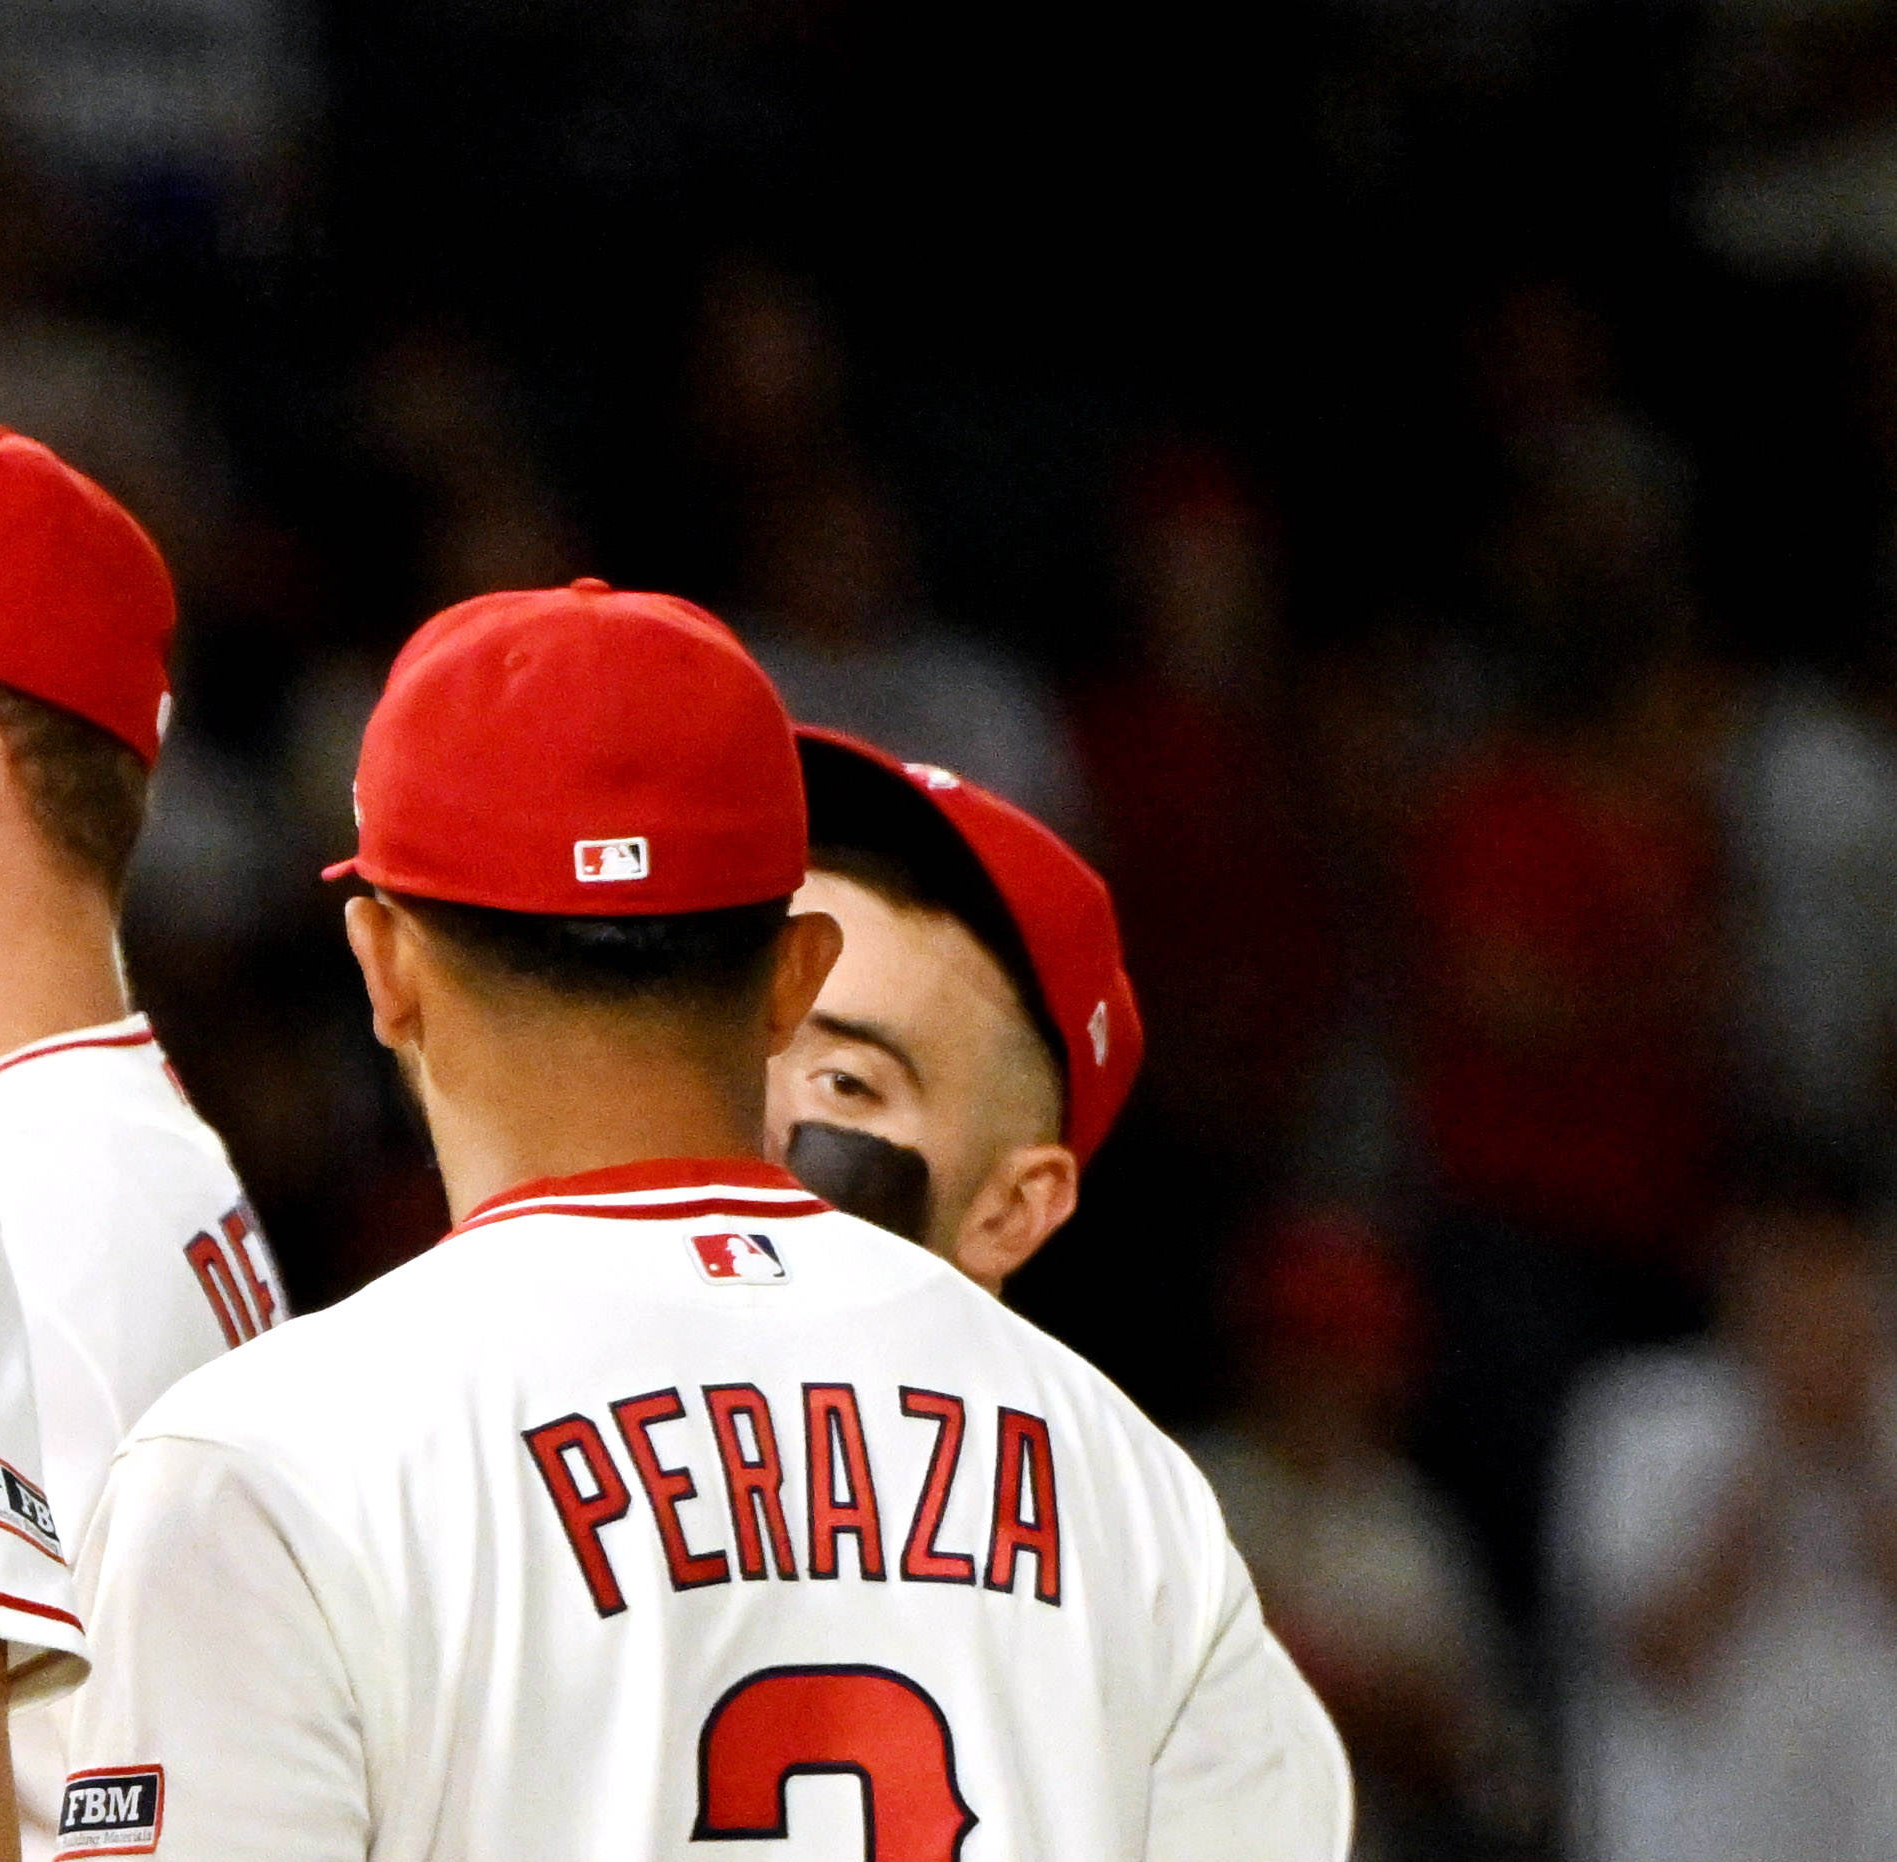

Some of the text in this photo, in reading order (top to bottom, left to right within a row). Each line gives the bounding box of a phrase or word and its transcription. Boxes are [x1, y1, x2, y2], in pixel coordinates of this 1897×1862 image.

[15, 1481, 57, 1536] FB
[519, 1381, 1064, 1620] PERAZA
[65, 1784, 143, 1827] FBM
